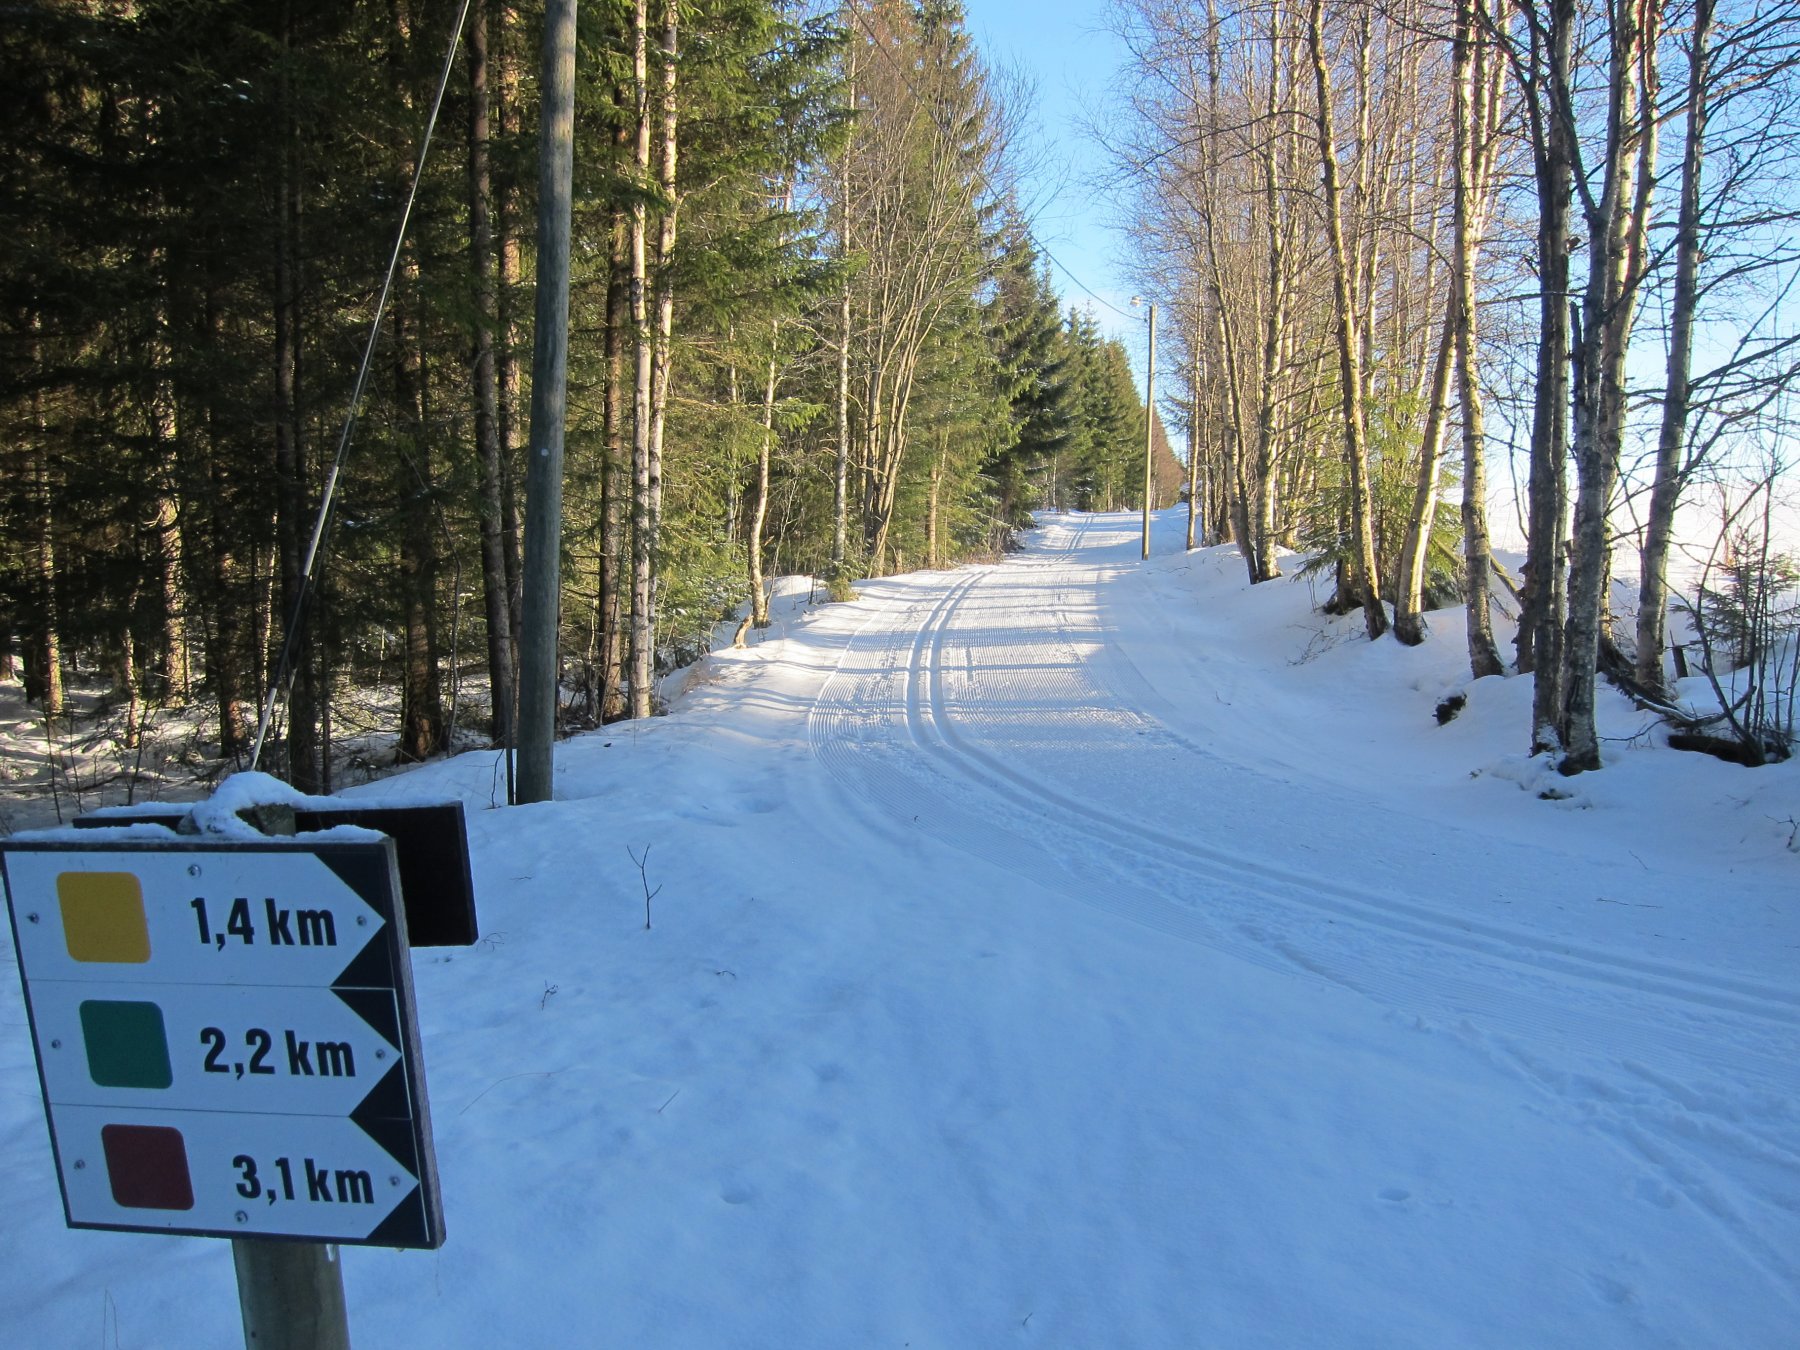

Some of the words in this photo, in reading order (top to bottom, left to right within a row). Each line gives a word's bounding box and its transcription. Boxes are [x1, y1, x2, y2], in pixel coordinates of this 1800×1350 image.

[190, 896, 256, 953] 1,4
[264, 897, 338, 947] km
[199, 1026, 276, 1081] 2,2
[284, 1029, 357, 1078] km
[232, 1154, 296, 1207] 3,1
[303, 1157, 375, 1205] km
